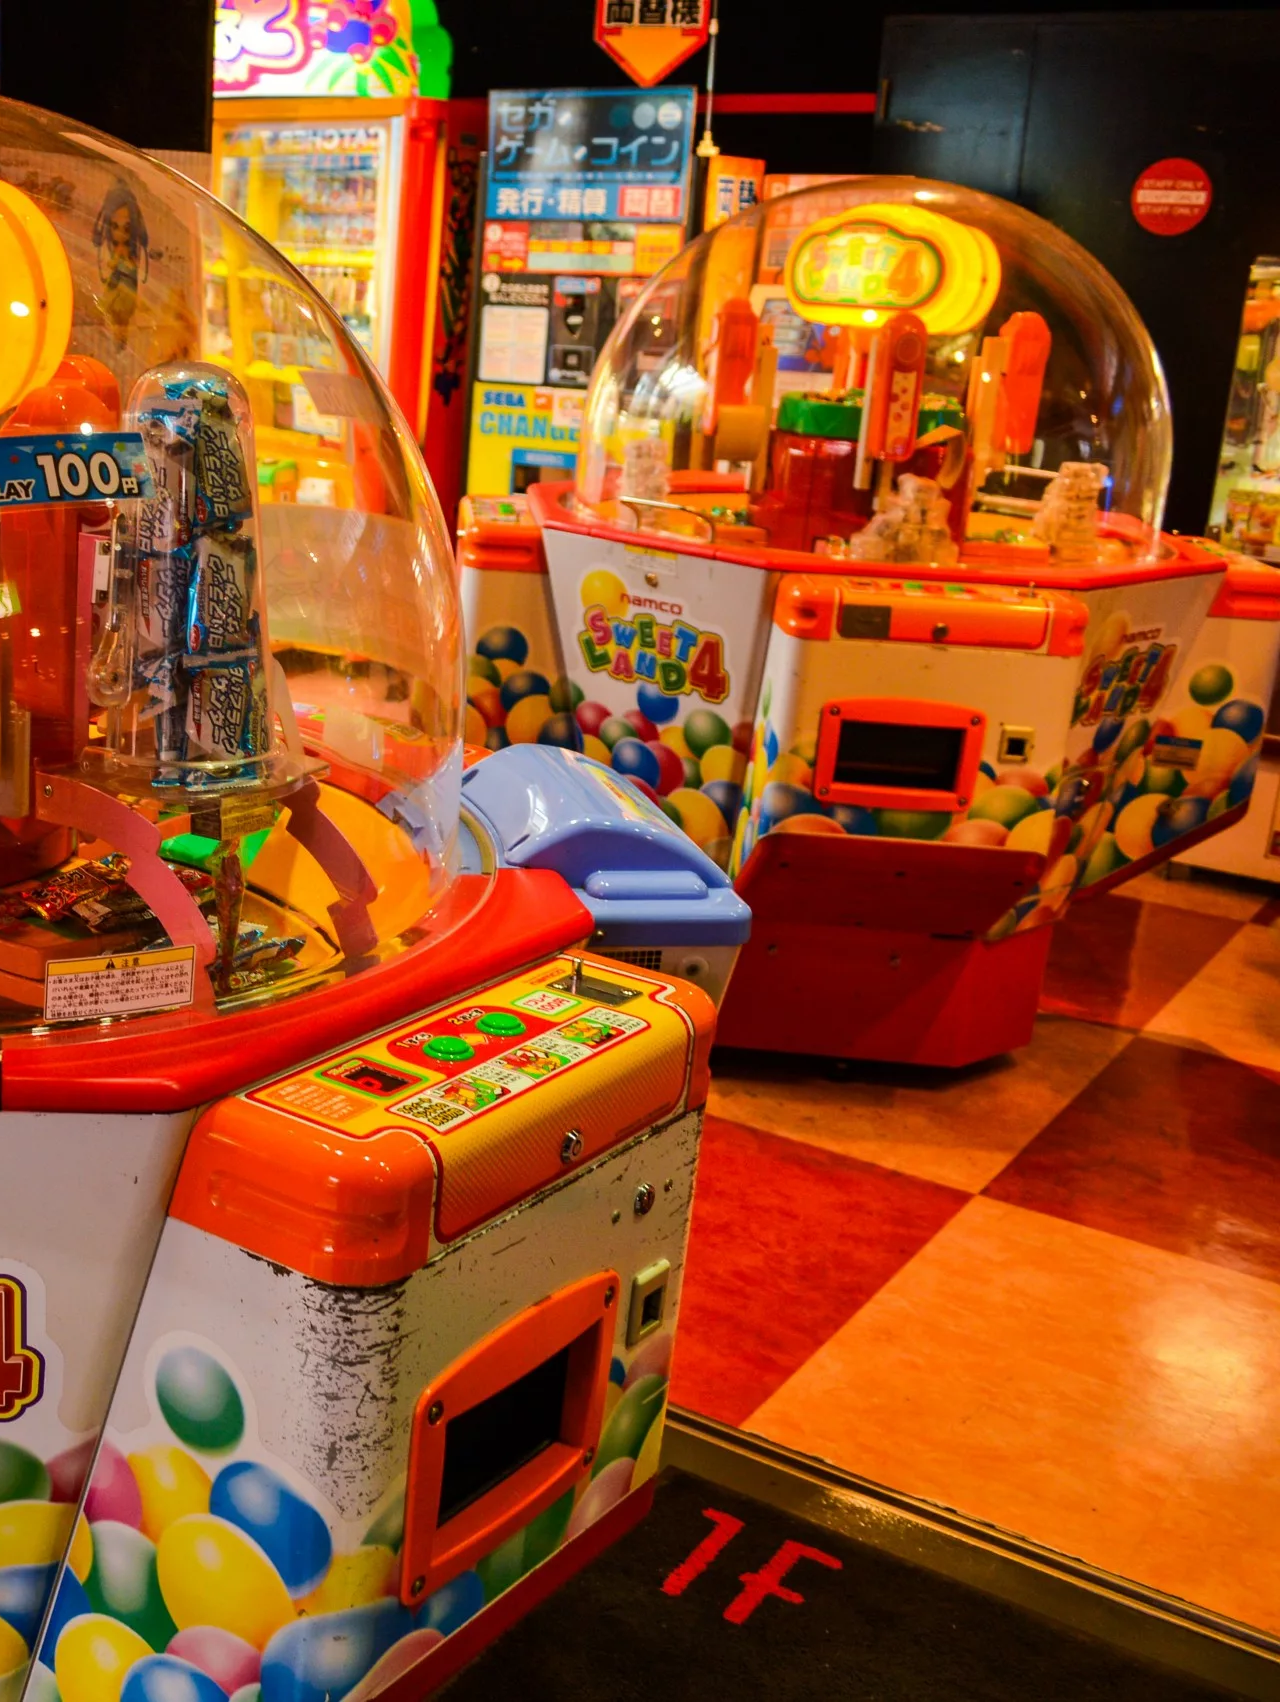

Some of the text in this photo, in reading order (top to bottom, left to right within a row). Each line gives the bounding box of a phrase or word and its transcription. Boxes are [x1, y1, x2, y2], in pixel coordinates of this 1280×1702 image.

[887, 249, 922, 299] 4
[36, 451, 140, 498] 100円
[620, 592, 684, 616] namco
[587, 610, 699, 663] SWEET
[582, 635, 729, 701] LAND 4
[659, 1507, 844, 1626] 1F
